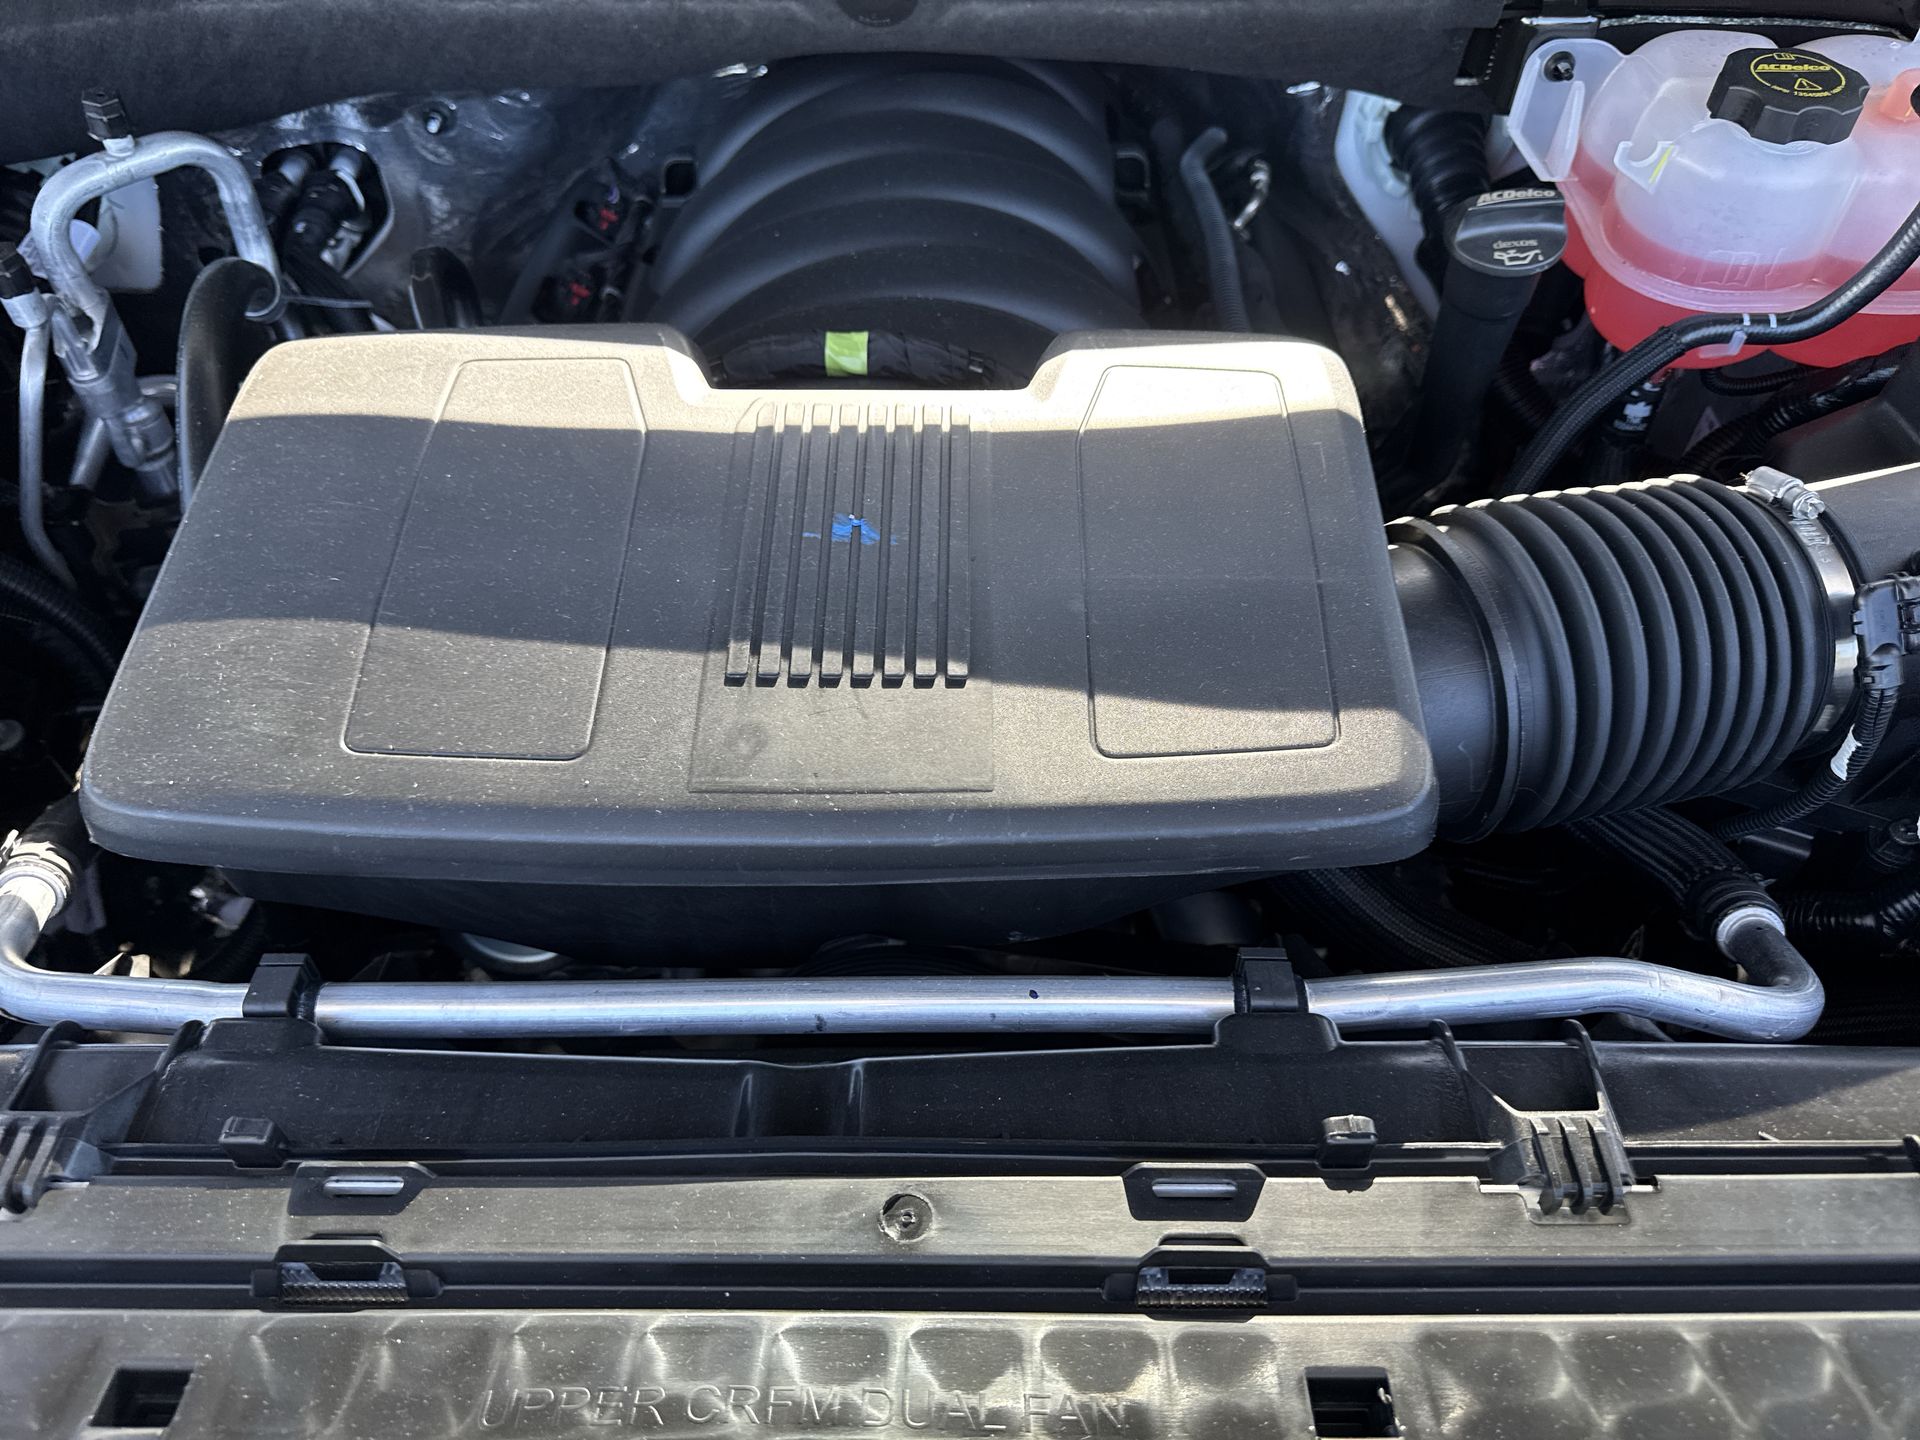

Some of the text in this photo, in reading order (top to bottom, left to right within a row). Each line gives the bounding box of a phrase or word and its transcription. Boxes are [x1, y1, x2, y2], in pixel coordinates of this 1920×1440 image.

[1756, 63, 1832, 72] ACDelco
[1477, 189, 1556, 206] ACDelco
[1492, 239, 1539, 250] dexos
[479, 1384, 1127, 1437] UPPER CRFM DUAL FAN
